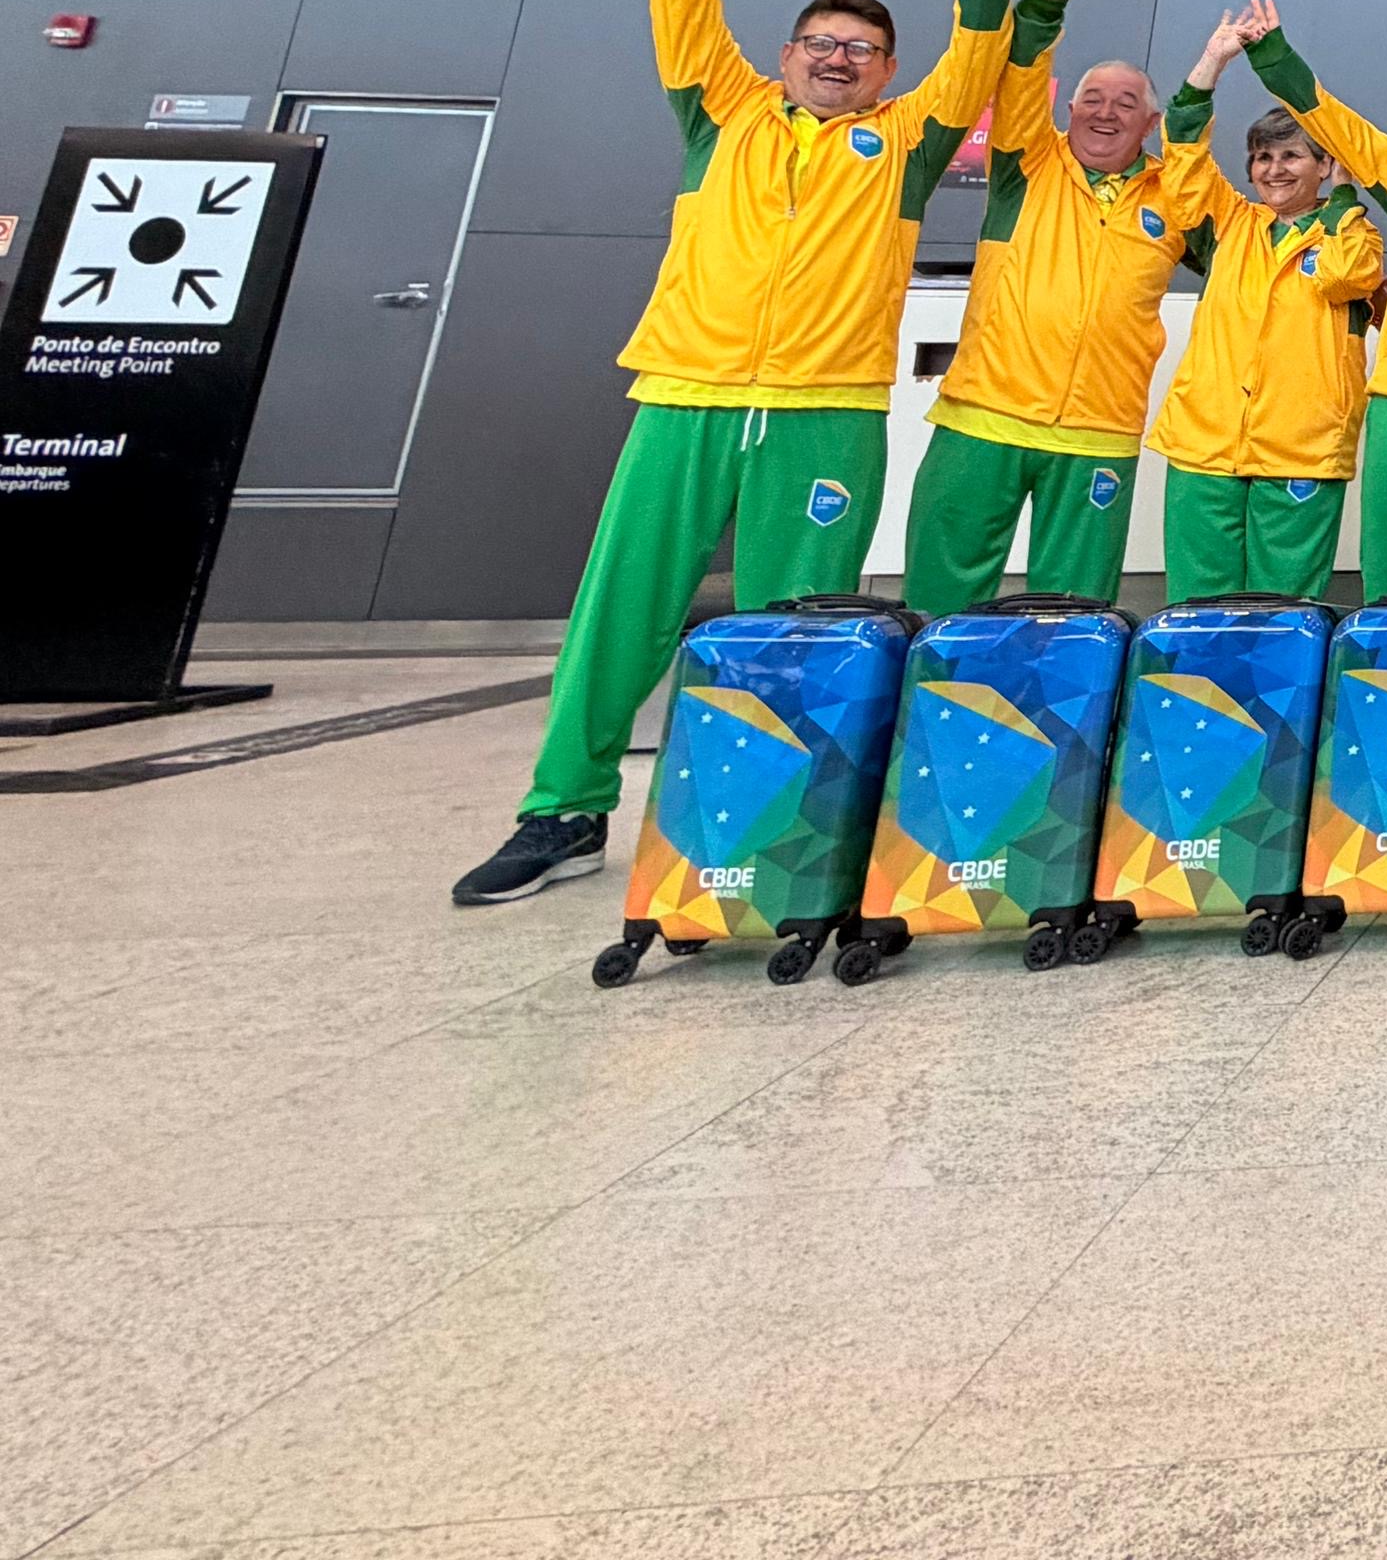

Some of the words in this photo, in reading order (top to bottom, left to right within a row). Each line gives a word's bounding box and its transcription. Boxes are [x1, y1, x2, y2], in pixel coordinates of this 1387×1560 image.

[30, 336, 94, 353] Ponto
[97, 335, 125, 354] de
[127, 337, 221, 354] Encontro
[25, 356, 115, 378] Meeting
[118, 357, 174, 374] Point
[2, 433, 127, 458] Terminal
[0, 479, 70, 494] epartures
[1165, 838, 1221, 861] CBDE
[948, 858, 1007, 882] CBDE
[1178, 861, 1206, 870] BRASIL
[699, 867, 755, 888] CBDE
